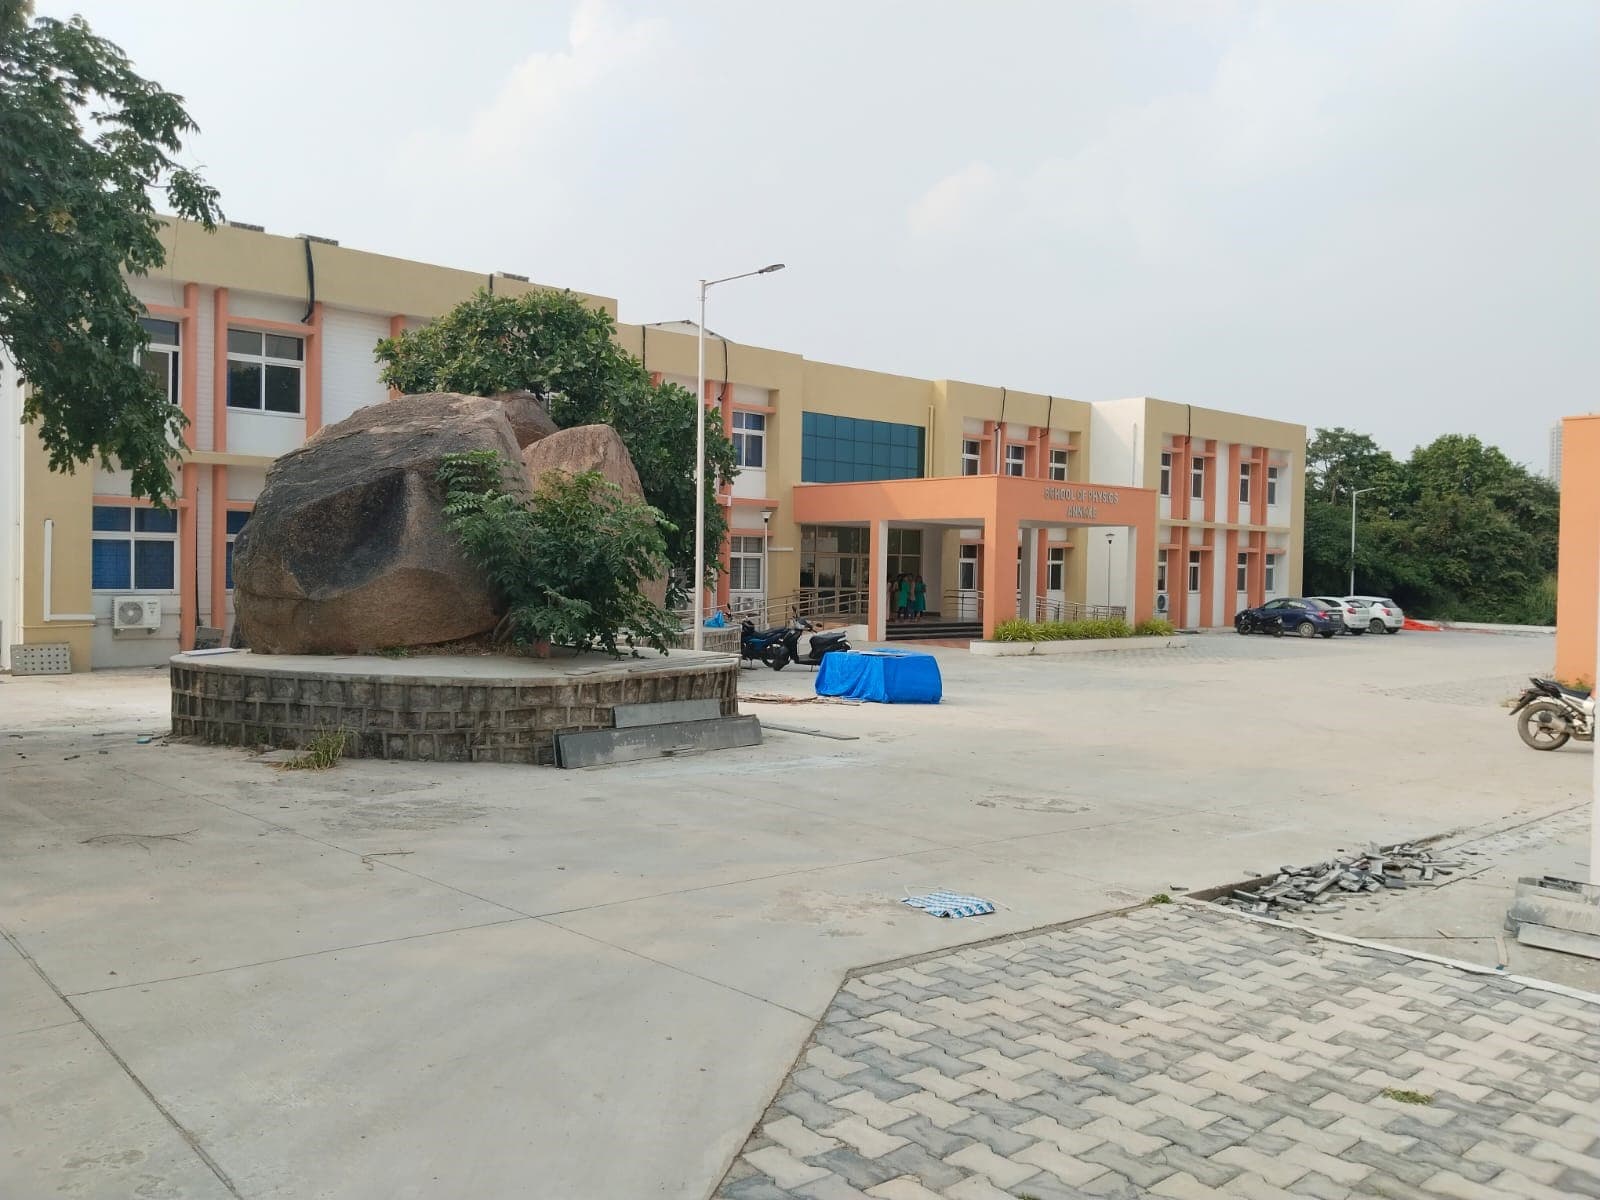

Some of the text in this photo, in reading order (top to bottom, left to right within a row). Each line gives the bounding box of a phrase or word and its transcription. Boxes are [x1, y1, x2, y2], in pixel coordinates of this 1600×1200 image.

[1044, 487, 1119, 504] SCHOOL OF PHYSICS
